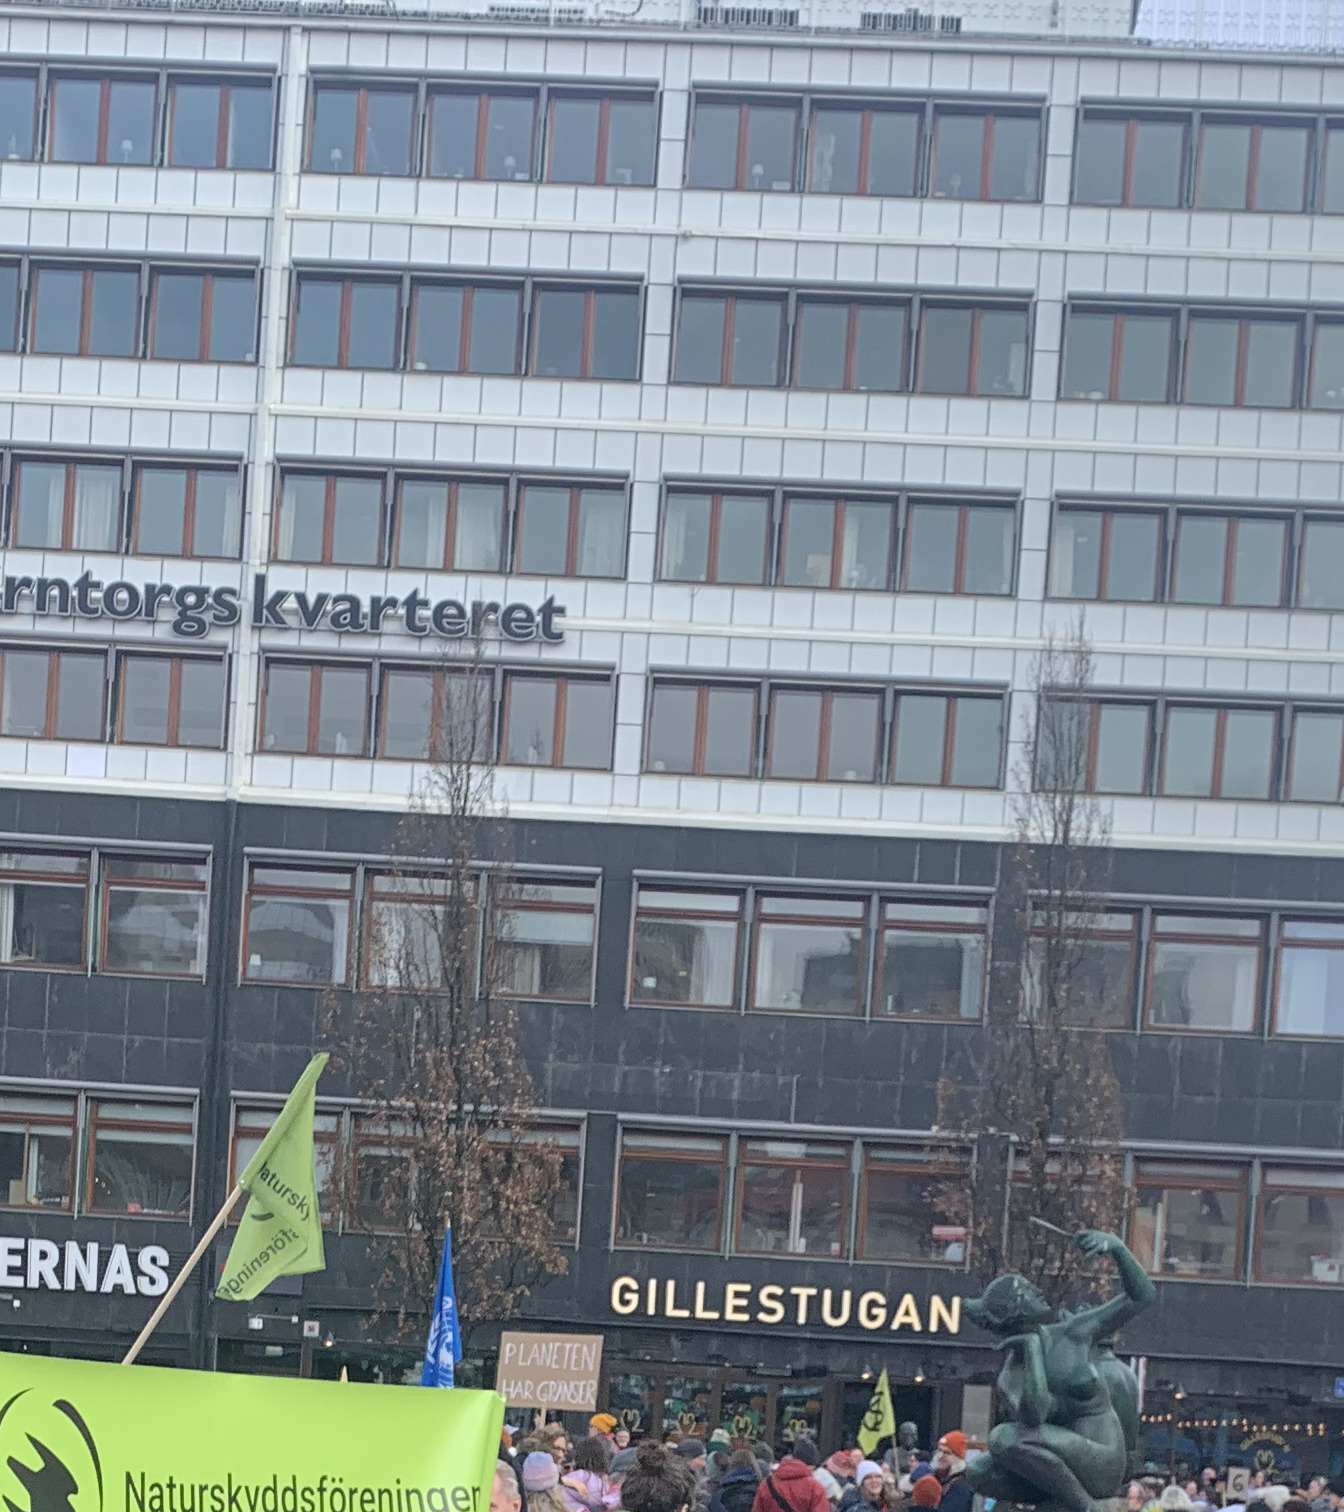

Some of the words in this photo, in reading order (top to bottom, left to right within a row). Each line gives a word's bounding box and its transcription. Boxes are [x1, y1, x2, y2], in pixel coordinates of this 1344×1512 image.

[611, 1276, 962, 1335] GILLESTUGAN
[504, 1342, 597, 1372] PLANETEN
[501, 1378, 534, 1401] HAR
[1233, 1473, 1244, 1492] 6
